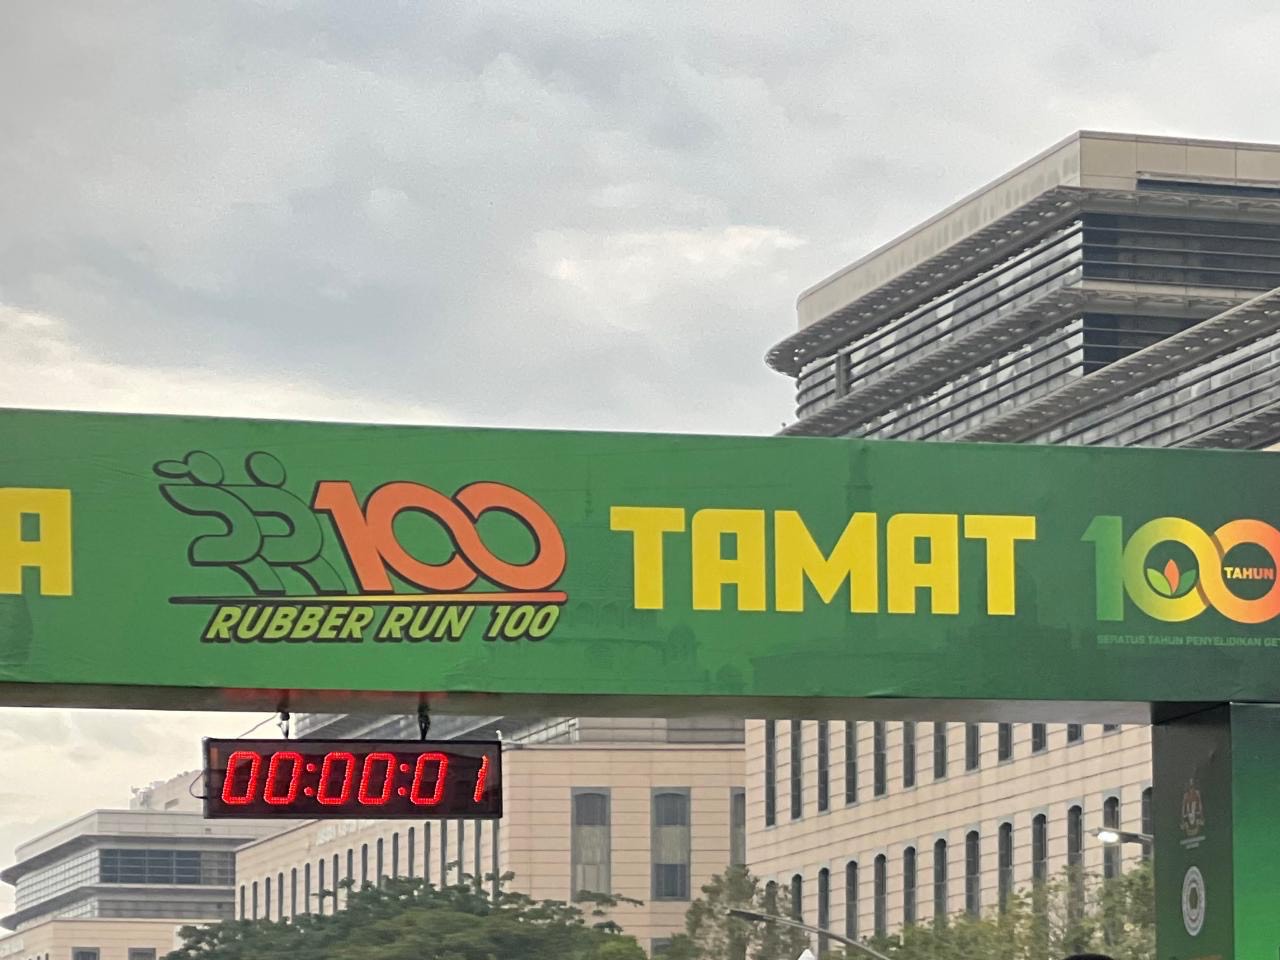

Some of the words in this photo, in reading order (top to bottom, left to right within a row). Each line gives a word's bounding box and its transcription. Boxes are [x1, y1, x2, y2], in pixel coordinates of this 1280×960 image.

[0, 487, 73, 596] A
[609, 505, 1037, 615] TAMAT
[1223, 566, 1274, 580] TAHUN
[203, 605, 375, 643] RUBBER
[374, 605, 475, 643] RUN
[483, 604, 561, 642] 100
[1147, 635, 1184, 646] TAHUN
